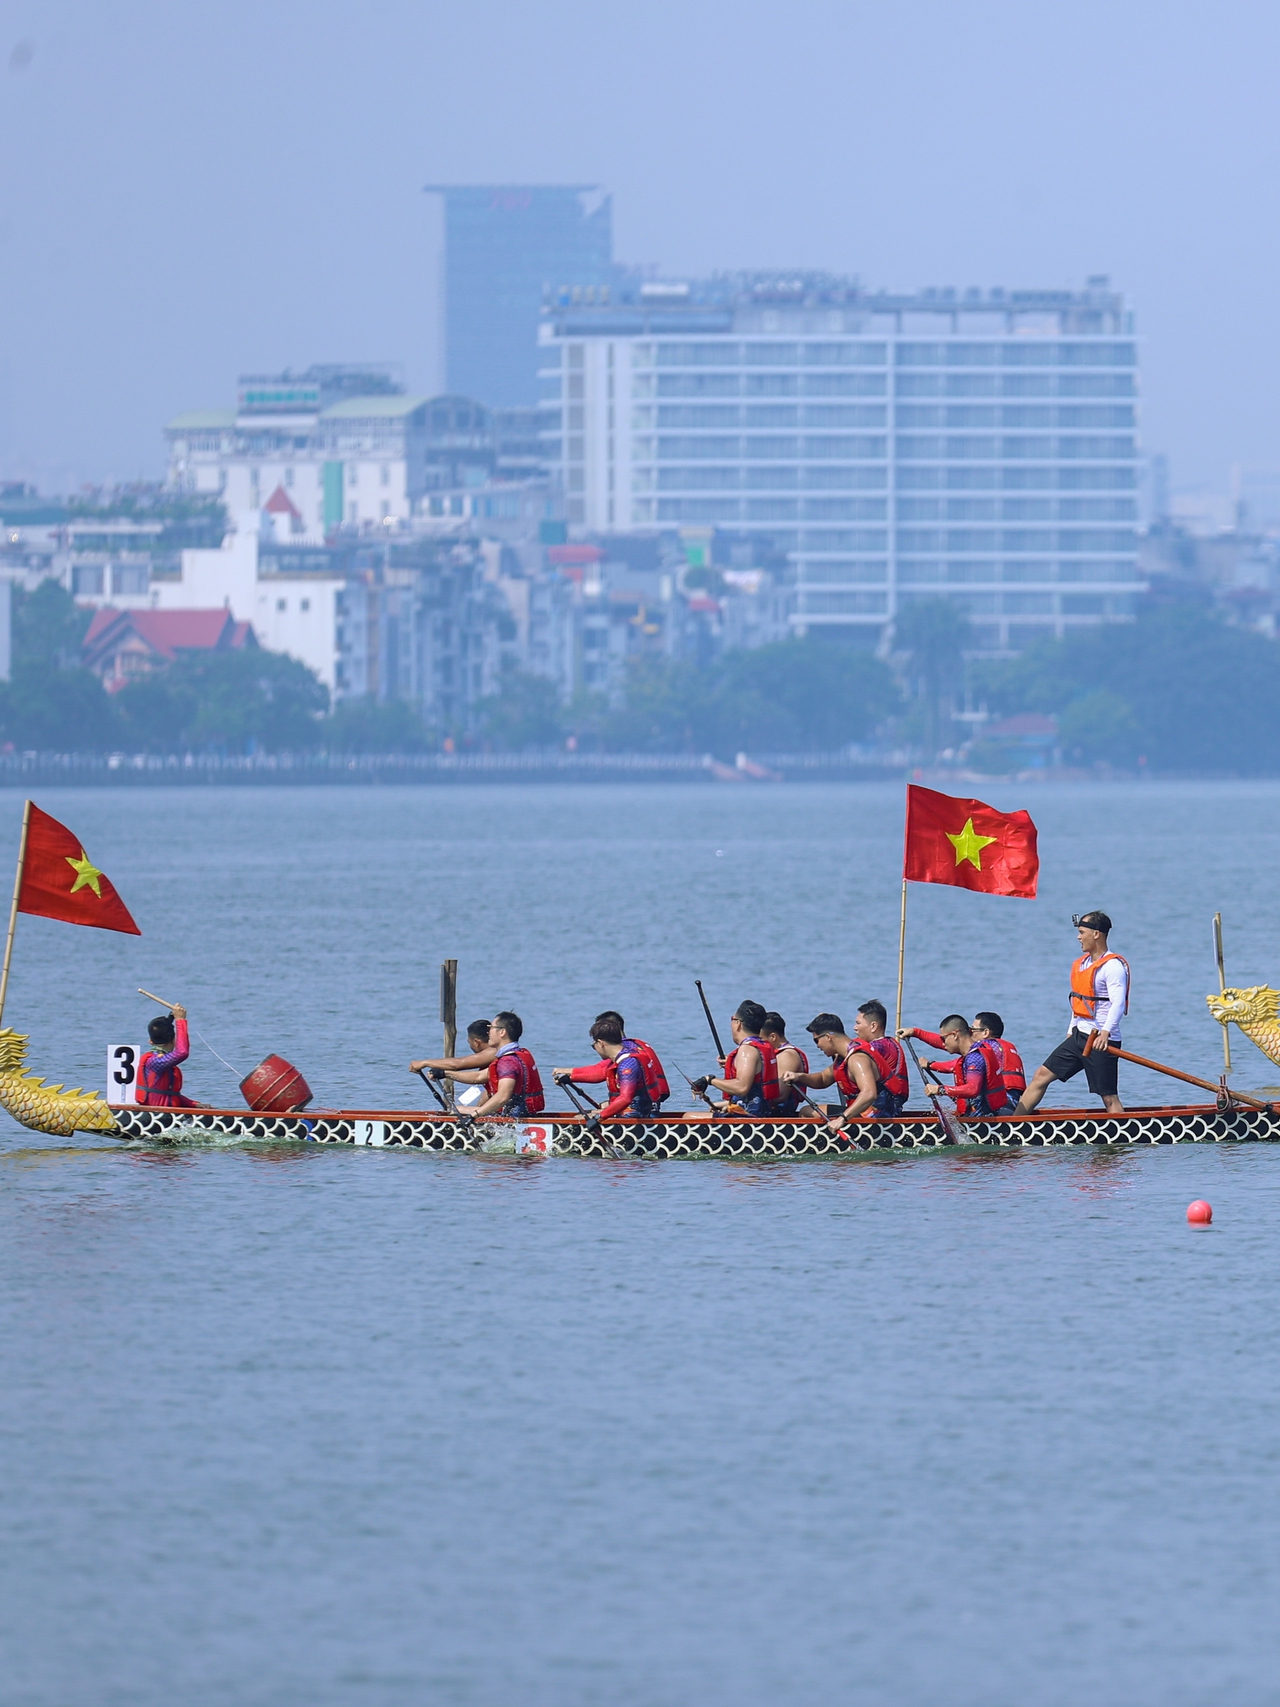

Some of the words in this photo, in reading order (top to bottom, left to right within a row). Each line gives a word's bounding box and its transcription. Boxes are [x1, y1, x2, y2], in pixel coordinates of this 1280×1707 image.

[113, 1046, 135, 1085] 3
[366, 1122, 373, 1145] 2
[521, 1126, 547, 1154] 3
